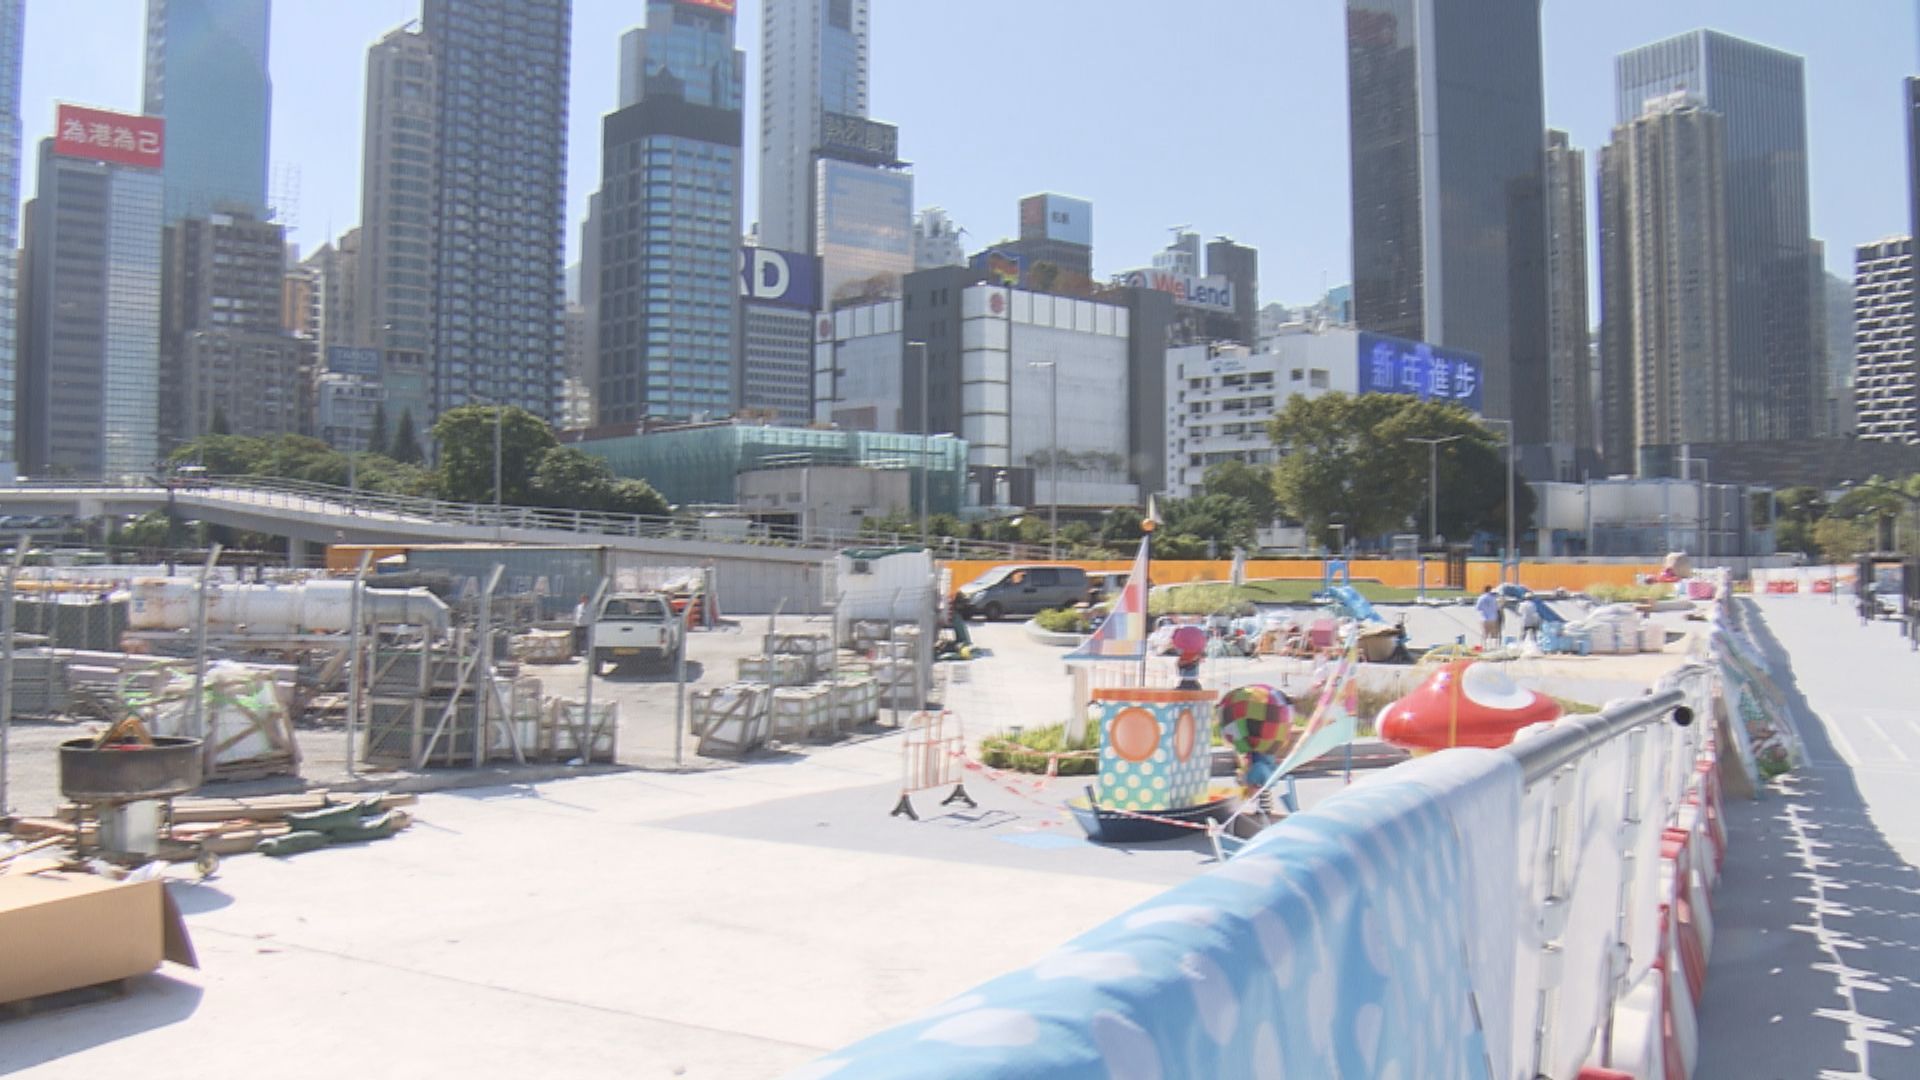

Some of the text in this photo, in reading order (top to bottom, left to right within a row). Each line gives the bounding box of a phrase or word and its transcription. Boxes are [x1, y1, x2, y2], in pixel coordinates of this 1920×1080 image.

[63, 118, 161, 154] 為港為己
[1152, 271, 1231, 307] WeLend
[1371, 346, 1476, 398] 新年進步
